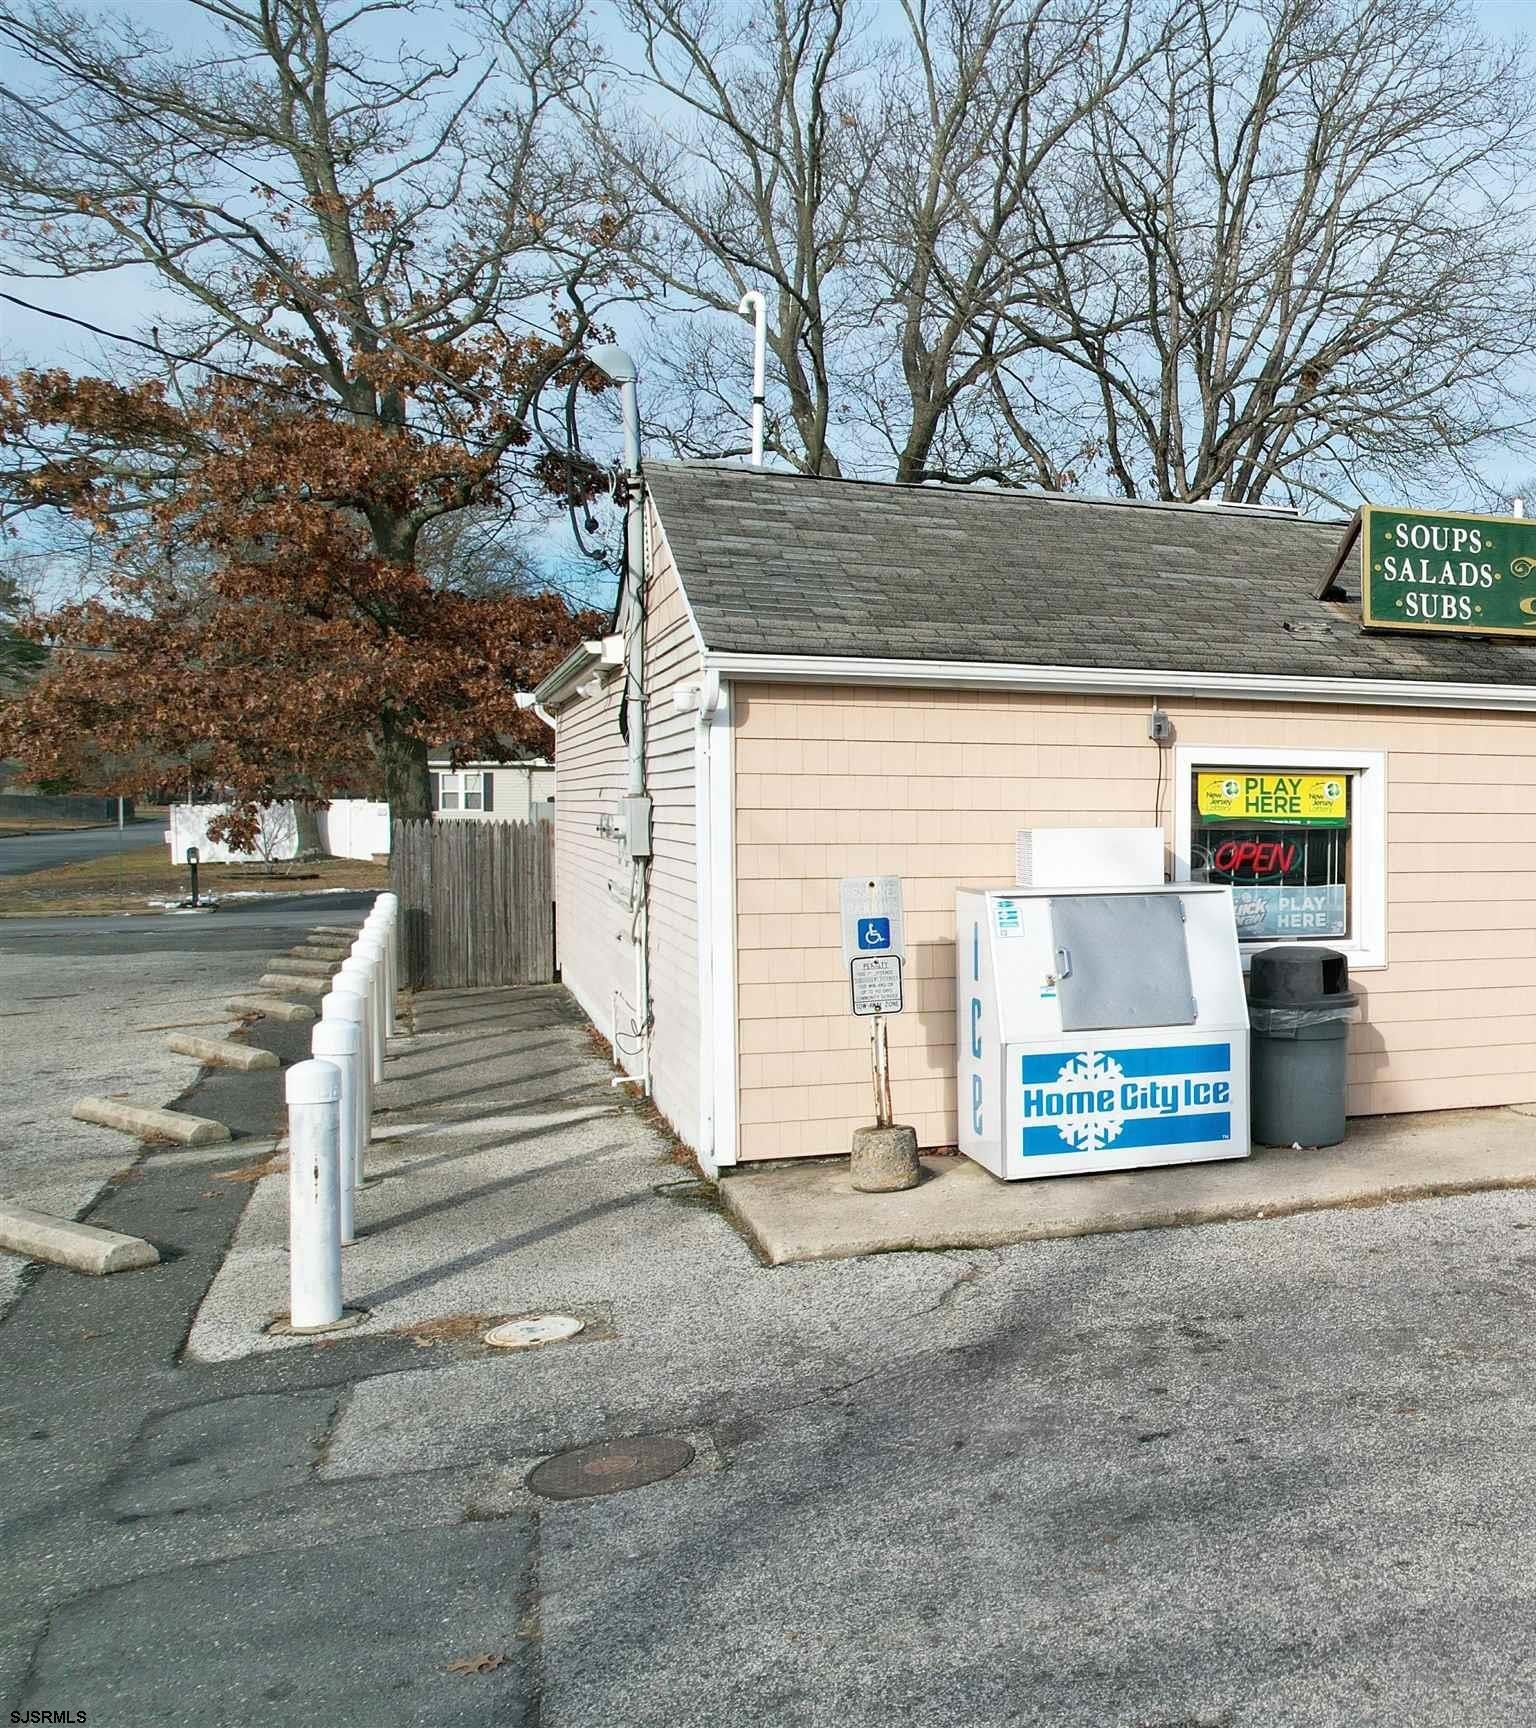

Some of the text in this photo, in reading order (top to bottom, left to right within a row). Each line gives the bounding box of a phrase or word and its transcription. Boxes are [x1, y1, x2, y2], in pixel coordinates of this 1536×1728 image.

[1395, 523, 1482, 554] SOUPS
[1384, 556, 1493, 588] SALADS
[1406, 592, 1472, 620] SUBS
[1245, 777, 1302, 796] PLAY
[1245, 796, 1301, 813] HERE
[1214, 840, 1296, 873] OPEN
[1279, 897, 1325, 911] PLAY
[1278, 912, 1327, 928] HERE
[1024, 1079, 1230, 1118] Home City Ice
